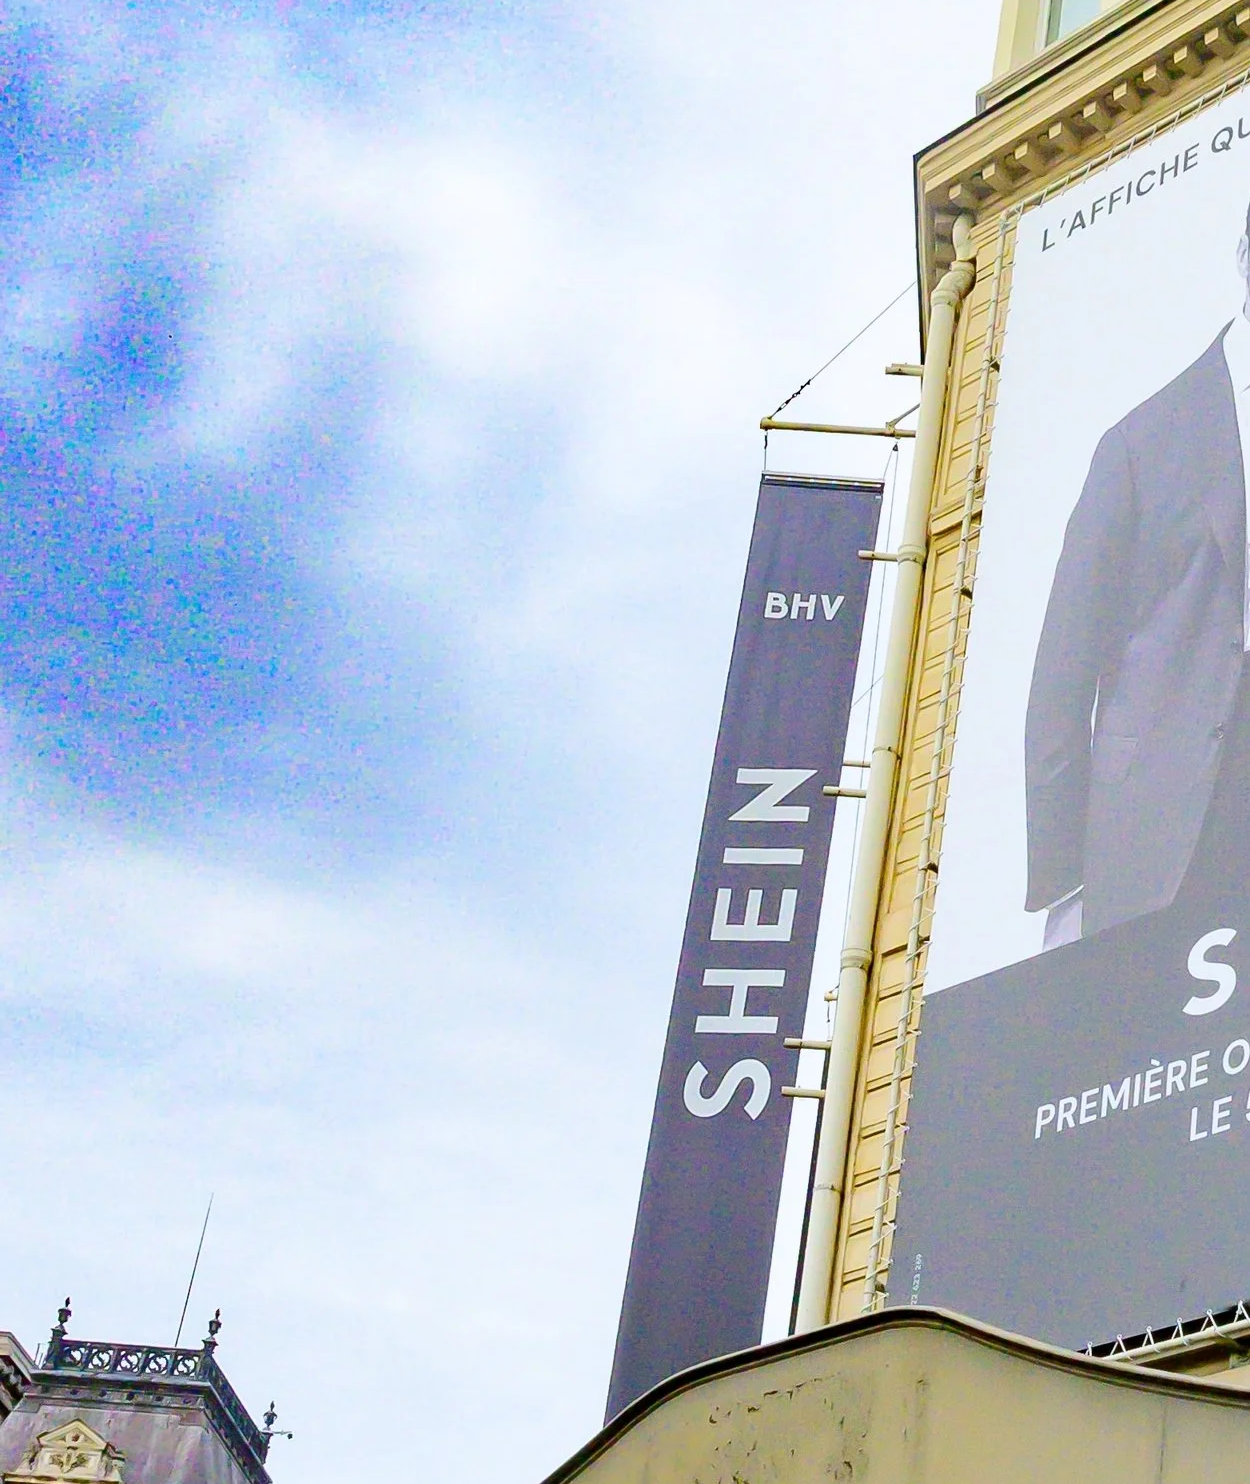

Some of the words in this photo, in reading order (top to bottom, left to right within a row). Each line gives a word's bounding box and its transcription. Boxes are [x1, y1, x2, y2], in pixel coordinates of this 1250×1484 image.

[1041, 143, 1201, 253] L'AFFICHE
[763, 592, 845, 623] BHV
[684, 766, 818, 1121] SHEIN
[1033, 1050, 1210, 1140] PREMIÈRE
[1189, 1099, 1233, 1142] LE
